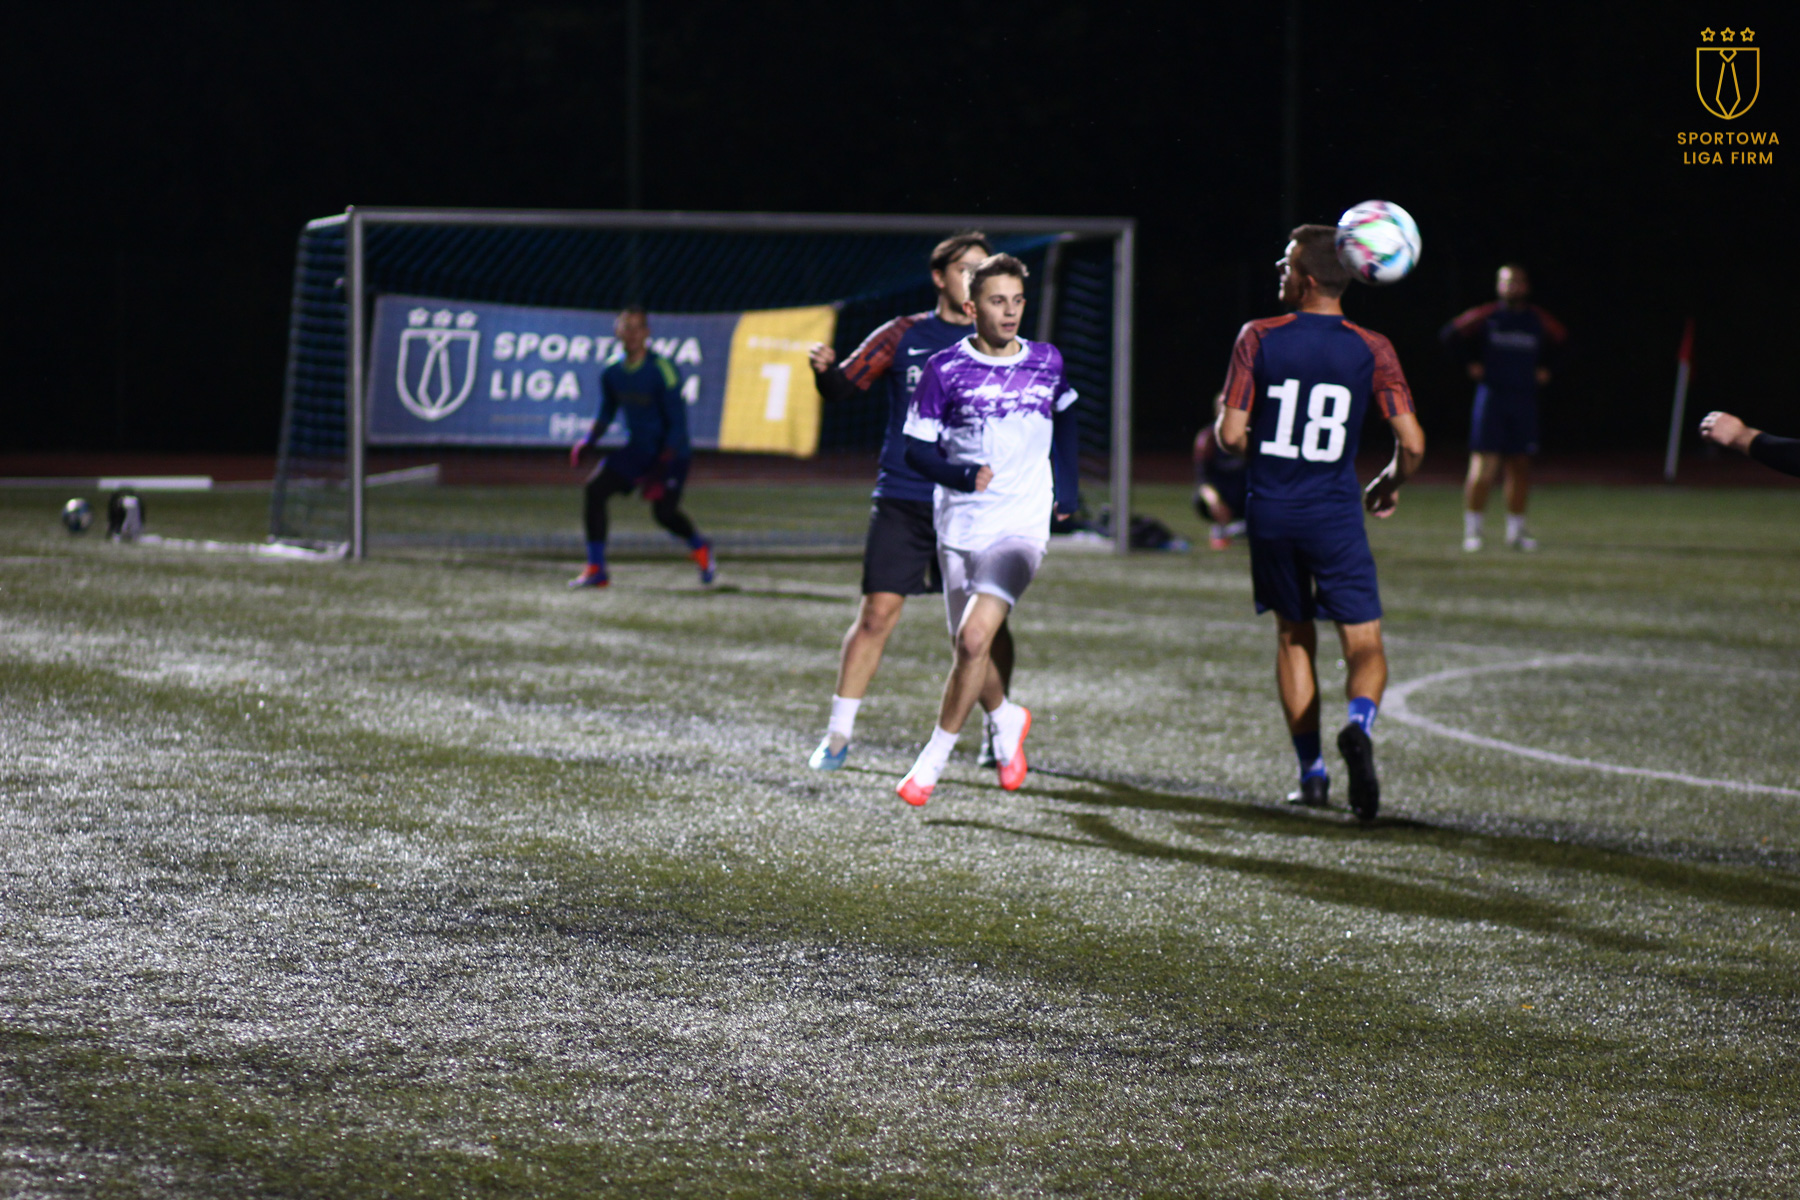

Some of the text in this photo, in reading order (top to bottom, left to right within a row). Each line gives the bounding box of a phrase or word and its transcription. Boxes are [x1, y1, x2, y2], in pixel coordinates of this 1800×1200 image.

[490, 369, 580, 401] LIGA
[761, 363, 790, 420] 1
[1260, 378, 1351, 462] 18
